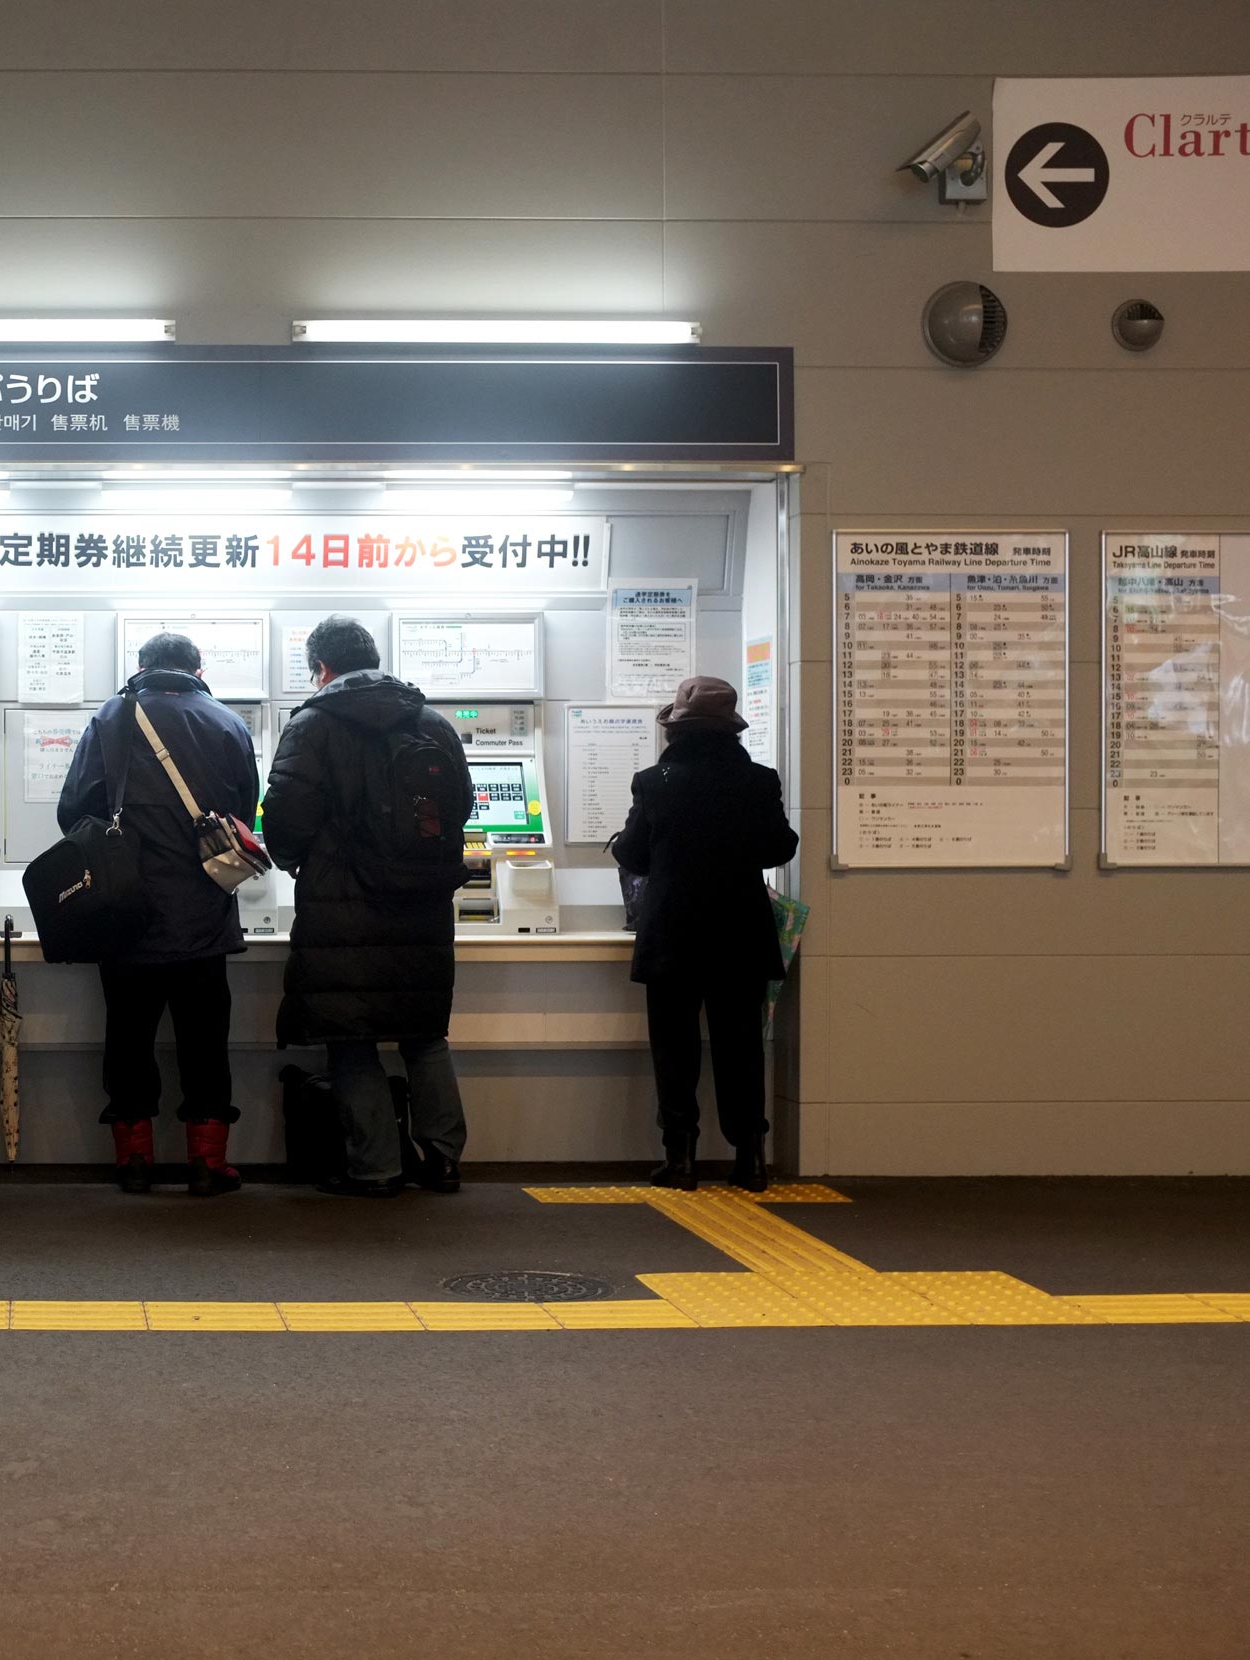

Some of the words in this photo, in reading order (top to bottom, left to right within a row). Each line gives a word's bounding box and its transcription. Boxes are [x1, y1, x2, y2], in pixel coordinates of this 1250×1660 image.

[1180, 113, 1231, 126] クラルテ
[50, 413, 108, 432] 售票机
[123, 413, 181, 432] 售票機
[850, 542, 999, 556] あいの風とやま鉄道線
[1113, 545, 1177, 559] JR高山線
[850, 558, 889, 566] Ainokaze
[892, 558, 926, 567] Toyama
[928, 558, 961, 567] Railway
[985, 558, 1028, 567] Departure
[1164, 562, 1196, 570] Departure
[844, 593, 850, 601] 5
[956, 593, 962, 601] 5
[844, 603, 850, 611] 6
[956, 603, 962, 611] 6
[844, 613, 850, 621] 7
[956, 613, 962, 621] 7
[844, 622, 850, 630] 8
[956, 623, 962, 631] 8
[1113, 625, 1118, 633] 8
[844, 632, 850, 640] 9
[956, 632, 962, 640] 9
[1113, 635, 1118, 643] 9
[842, 642, 852, 650] 10
[954, 642, 964, 650] 10
[1110, 644, 1121, 652] 10
[842, 652, 852, 660] 11
[954, 652, 964, 660] 11
[1110, 654, 1121, 662] 11
[842, 661, 852, 669] 12
[954, 662, 964, 670] 12
[1110, 664, 1121, 672] 12
[842, 671, 852, 679] 13
[954, 671, 964, 679] 13
[1110, 673, 1121, 681] 13
[842, 681, 852, 689] 14
[954, 681, 964, 689] 14
[842, 690, 852, 698] 15
[954, 691, 964, 699] 15
[1110, 693, 1121, 701] 15
[842, 700, 852, 708] 16
[954, 700, 964, 708] 16
[842, 710, 852, 718] 17
[954, 710, 964, 718] 17
[1110, 712, 1121, 720] 17
[842, 720, 852, 728] 18
[954, 720, 964, 728] 18
[1110, 722, 1121, 730] 18
[842, 729, 852, 737] 19
[954, 730, 964, 738] 19
[1110, 731, 1121, 739] 19
[842, 739, 852, 747] 20
[954, 739, 964, 747] 20
[1110, 741, 1121, 749] 20
[842, 749, 852, 757] 21
[954, 749, 964, 757] 21
[1110, 751, 1121, 759] 21
[842, 759, 852, 767] 22
[954, 759, 964, 767] 22
[1110, 760, 1121, 768] 22
[842, 768, 852, 776] 23
[954, 768, 964, 776] 23
[844, 778, 850, 786] 0
[956, 778, 962, 786] 0
[1113, 780, 1118, 788] 0
